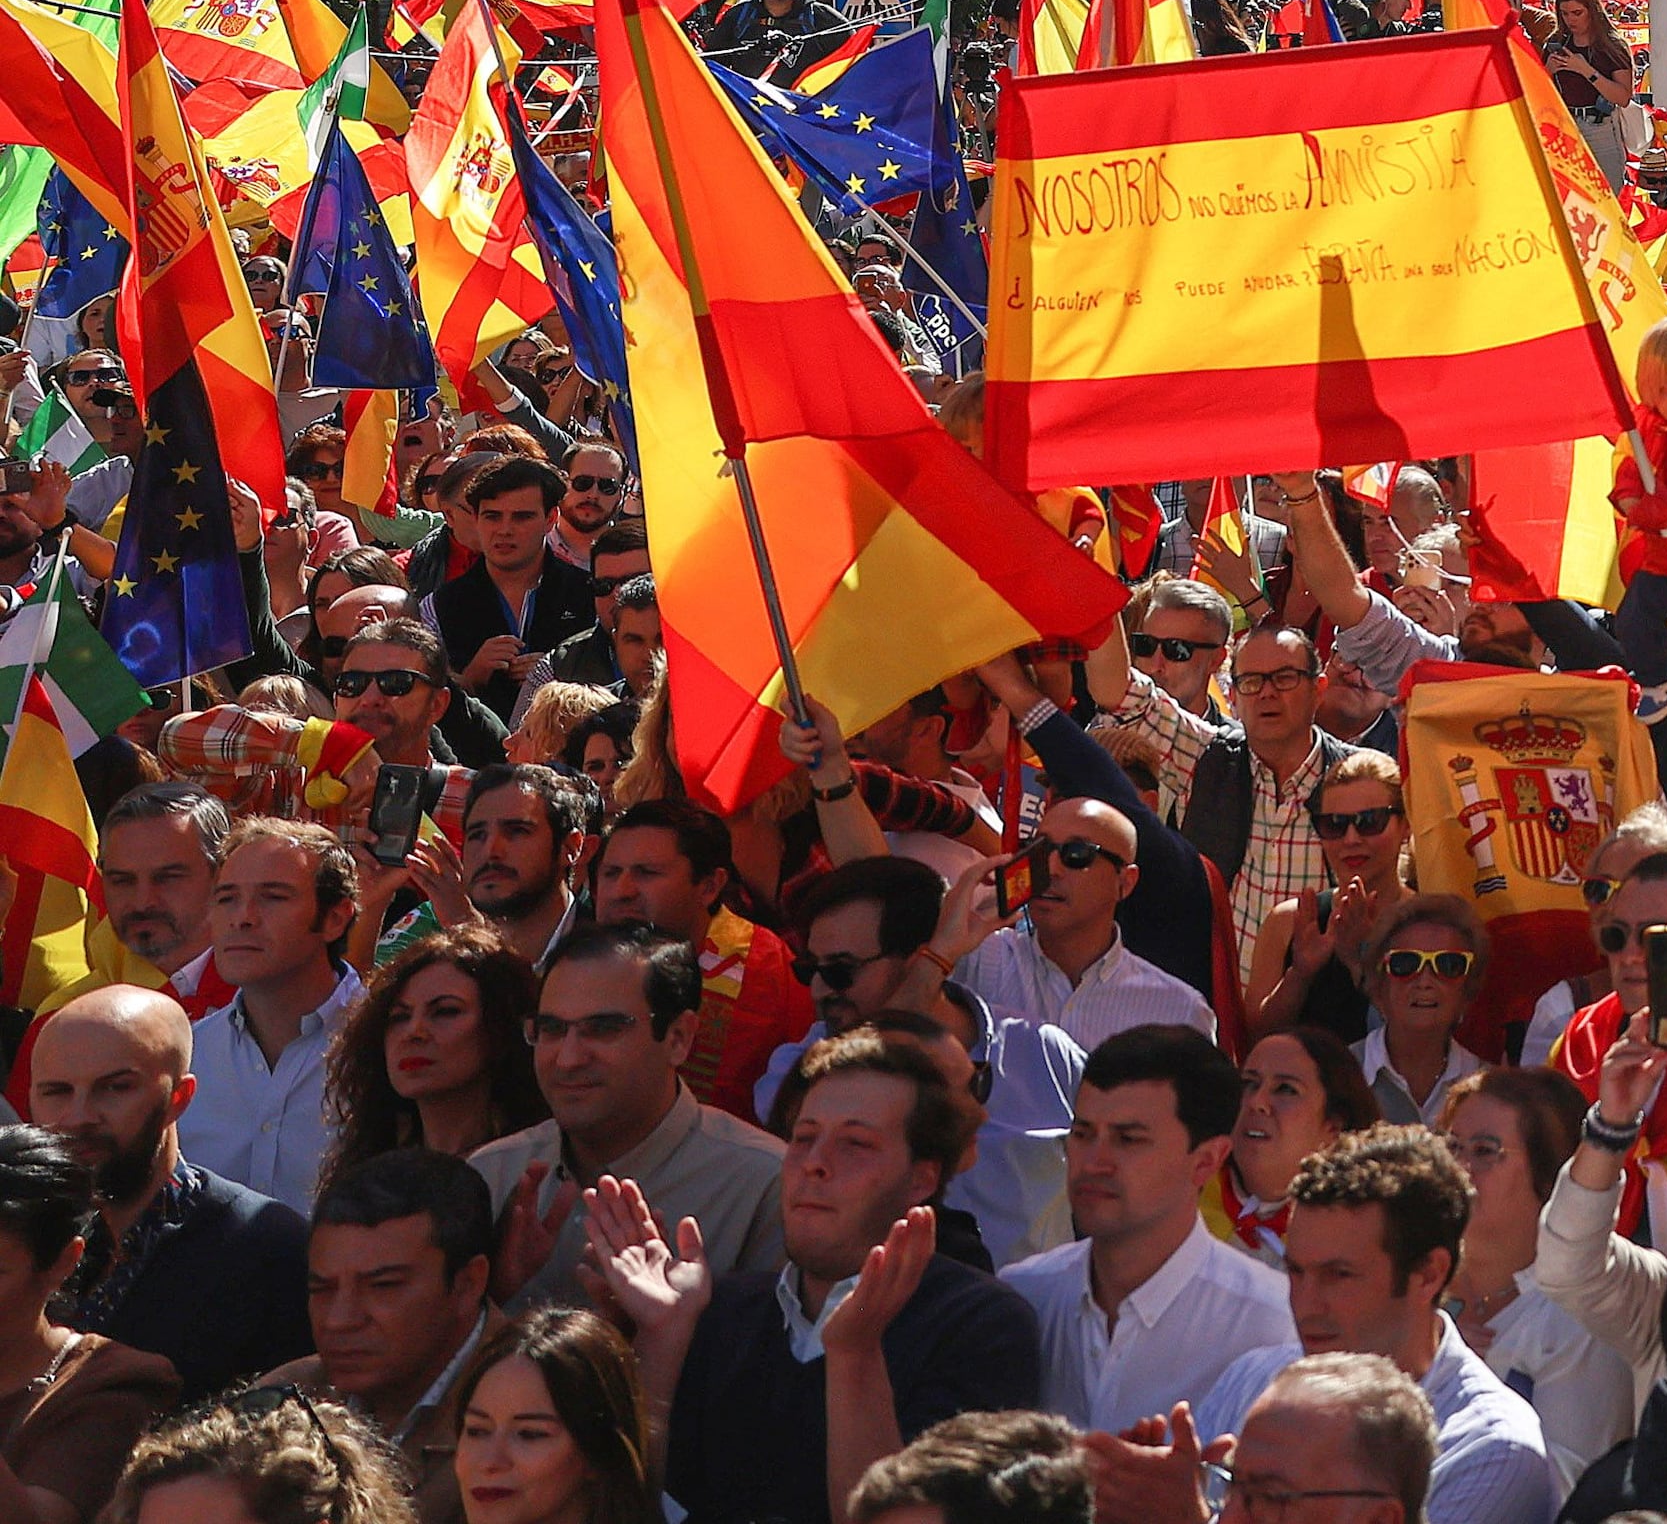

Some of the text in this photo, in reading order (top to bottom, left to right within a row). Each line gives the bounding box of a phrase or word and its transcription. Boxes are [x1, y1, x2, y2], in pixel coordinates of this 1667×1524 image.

[1014, 152, 1182, 238] NOSOTROS
[1188, 196, 1216, 219] NO
[1282, 192, 1300, 211] LA
[1174, 280, 1226, 297] PUEDE
